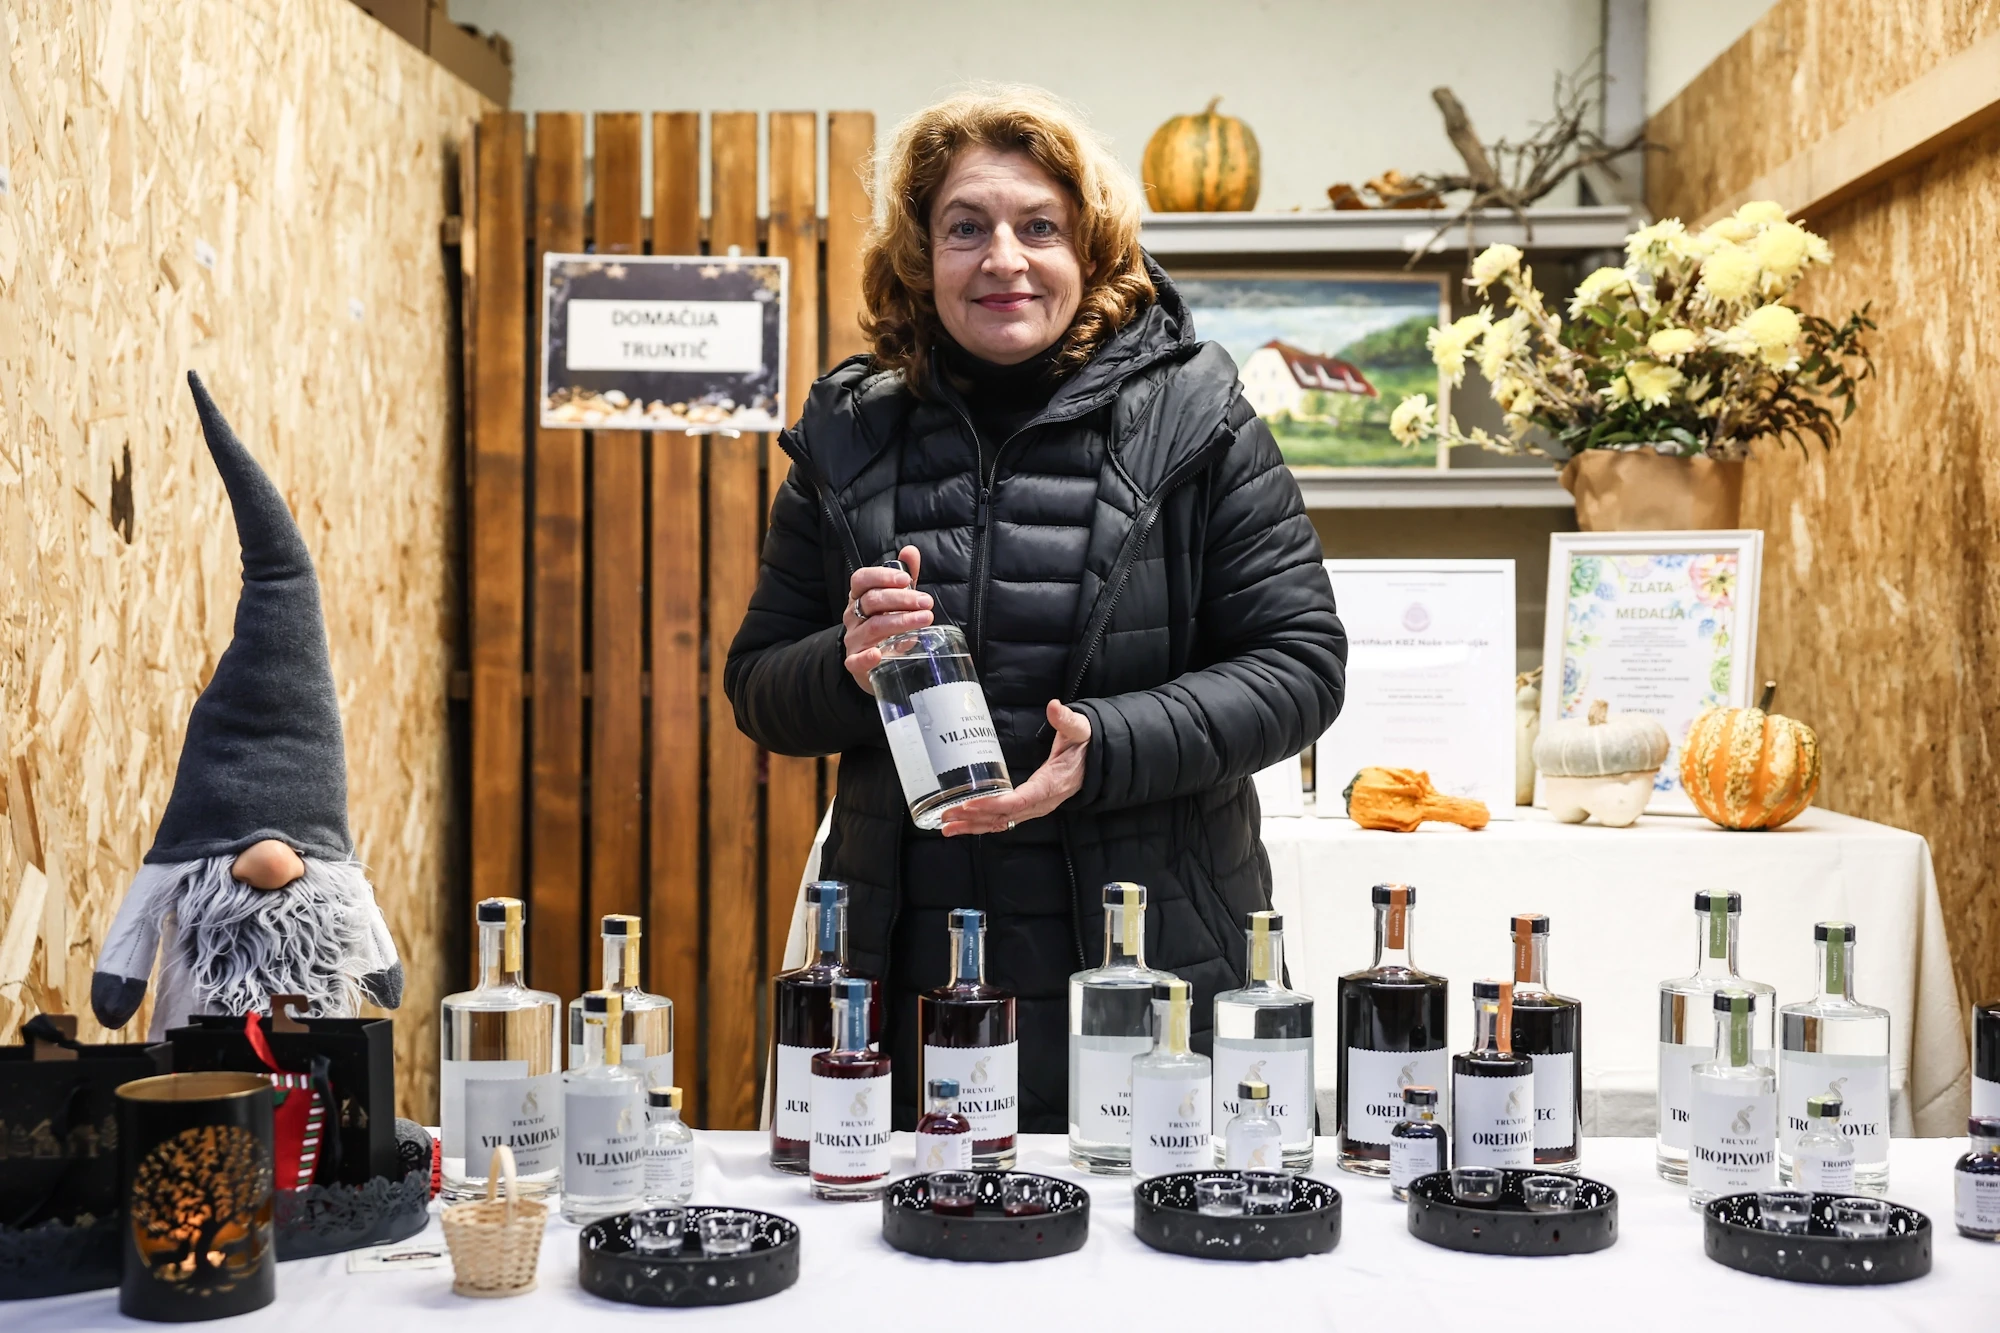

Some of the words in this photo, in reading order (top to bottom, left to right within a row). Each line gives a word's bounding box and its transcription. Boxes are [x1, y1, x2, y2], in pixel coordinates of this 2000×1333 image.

[611, 305, 719, 328] DOMAČIJA
[1629, 581, 1674, 594] ZLATA
[1616, 607, 1685, 620] MEDALJA
[961, 1085, 996, 1094] TRUNTIĆ
[958, 1101, 982, 1113] KIN
[986, 1096, 1016, 1112] LIKER
[815, 1131, 862, 1148] JURKIN
